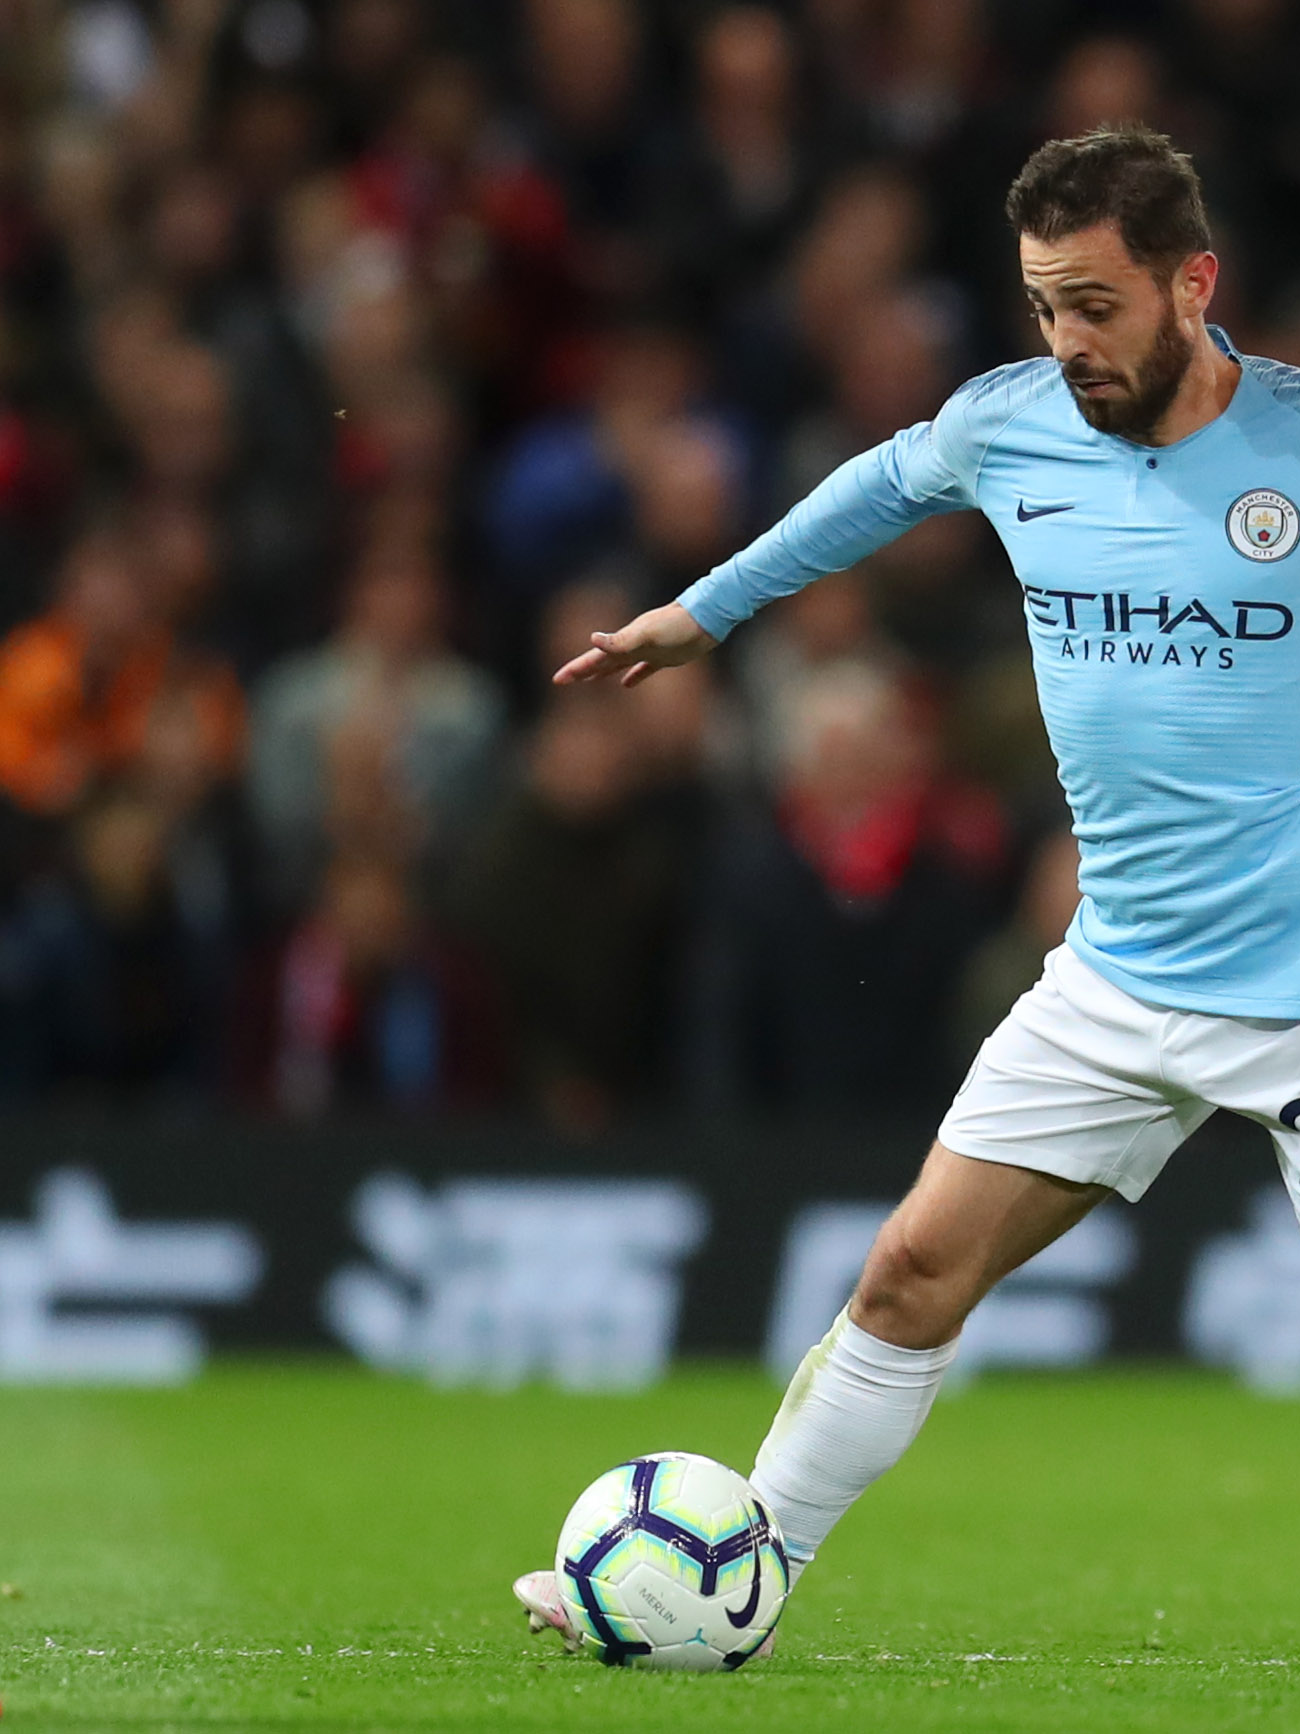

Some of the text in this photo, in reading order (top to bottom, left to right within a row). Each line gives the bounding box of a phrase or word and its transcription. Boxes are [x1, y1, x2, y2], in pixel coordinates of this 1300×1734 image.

[1236, 494, 1294, 516] MANCHESTER
[1252, 549, 1275, 557] CITY
[1024, 584, 1294, 640] ETIHAD
[1061, 637, 1234, 669] AIRWAYS
[639, 1587, 678, 1625] MERLIN
